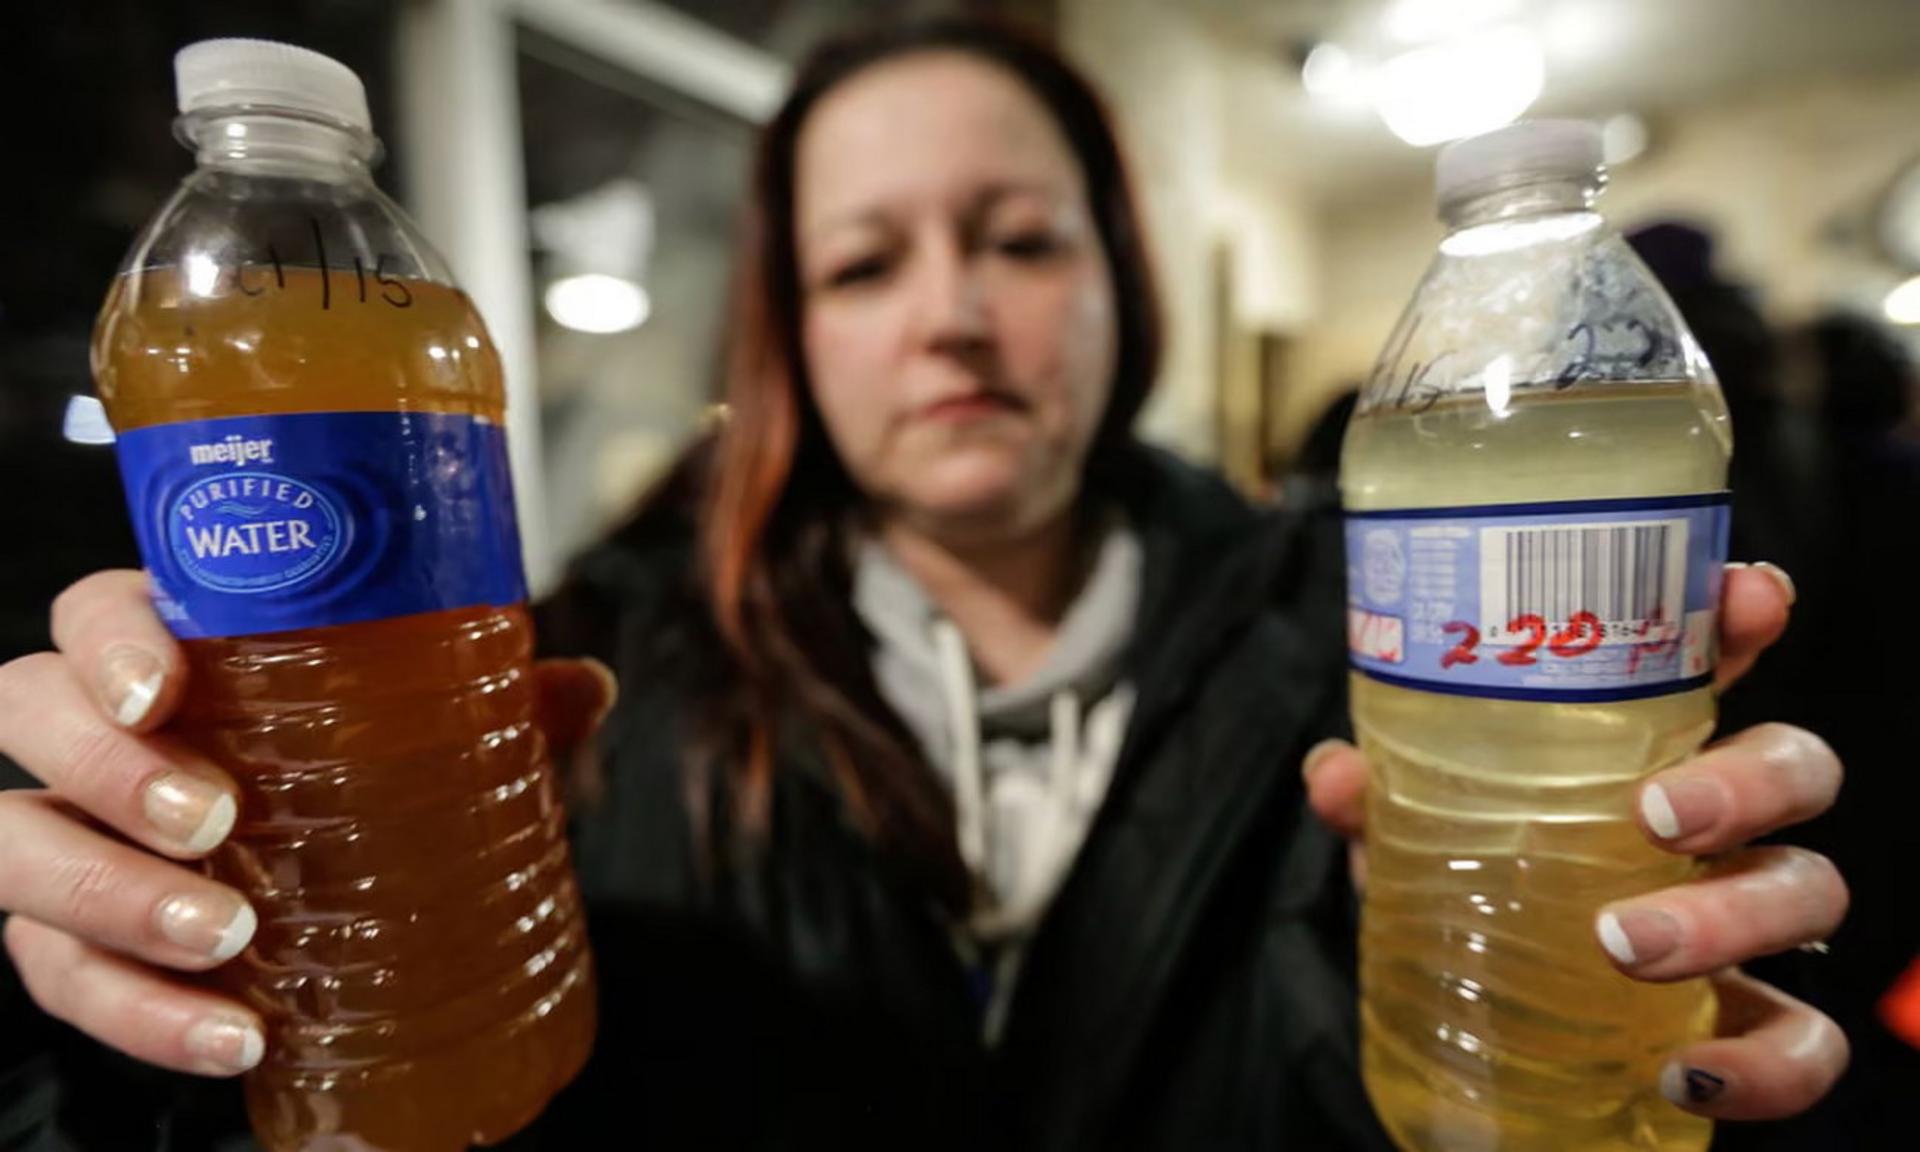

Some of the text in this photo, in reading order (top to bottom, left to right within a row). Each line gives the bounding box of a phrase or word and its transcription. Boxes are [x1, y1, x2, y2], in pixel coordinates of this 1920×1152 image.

[189, 434, 274, 467] meijer
[179, 478, 314, 521] PURIFIED
[186, 519, 317, 559] WATER
